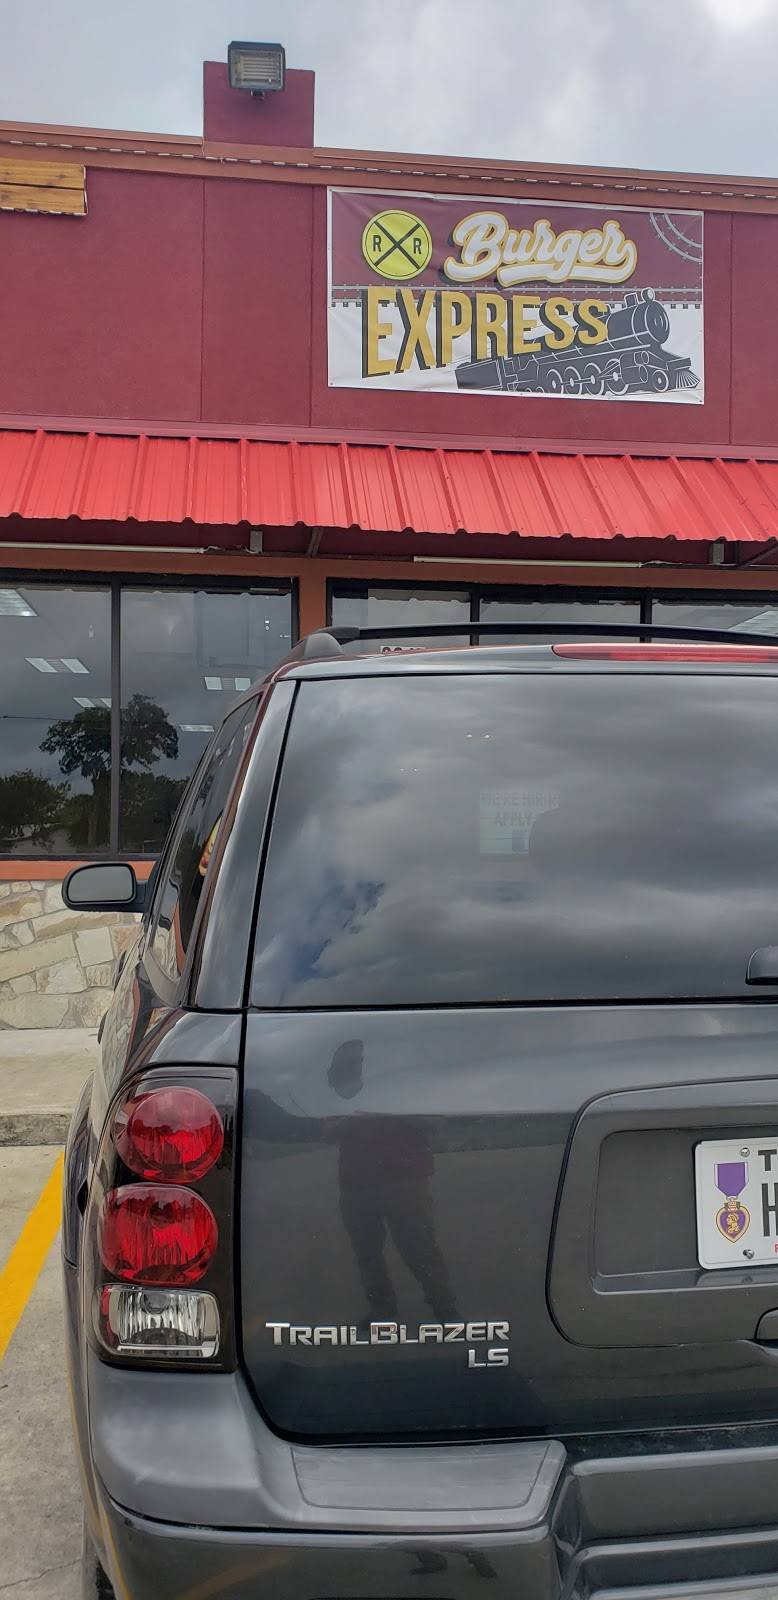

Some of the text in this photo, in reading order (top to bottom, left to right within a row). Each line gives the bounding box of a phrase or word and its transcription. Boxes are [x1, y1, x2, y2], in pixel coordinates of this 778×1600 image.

[372, 233, 422, 255] R R
[443, 210, 638, 287] Burger
[362, 286, 609, 378] EXPRESS
[265, 1321, 510, 1346] TRAILBLAZER
[468, 1348, 509, 1368] LS
